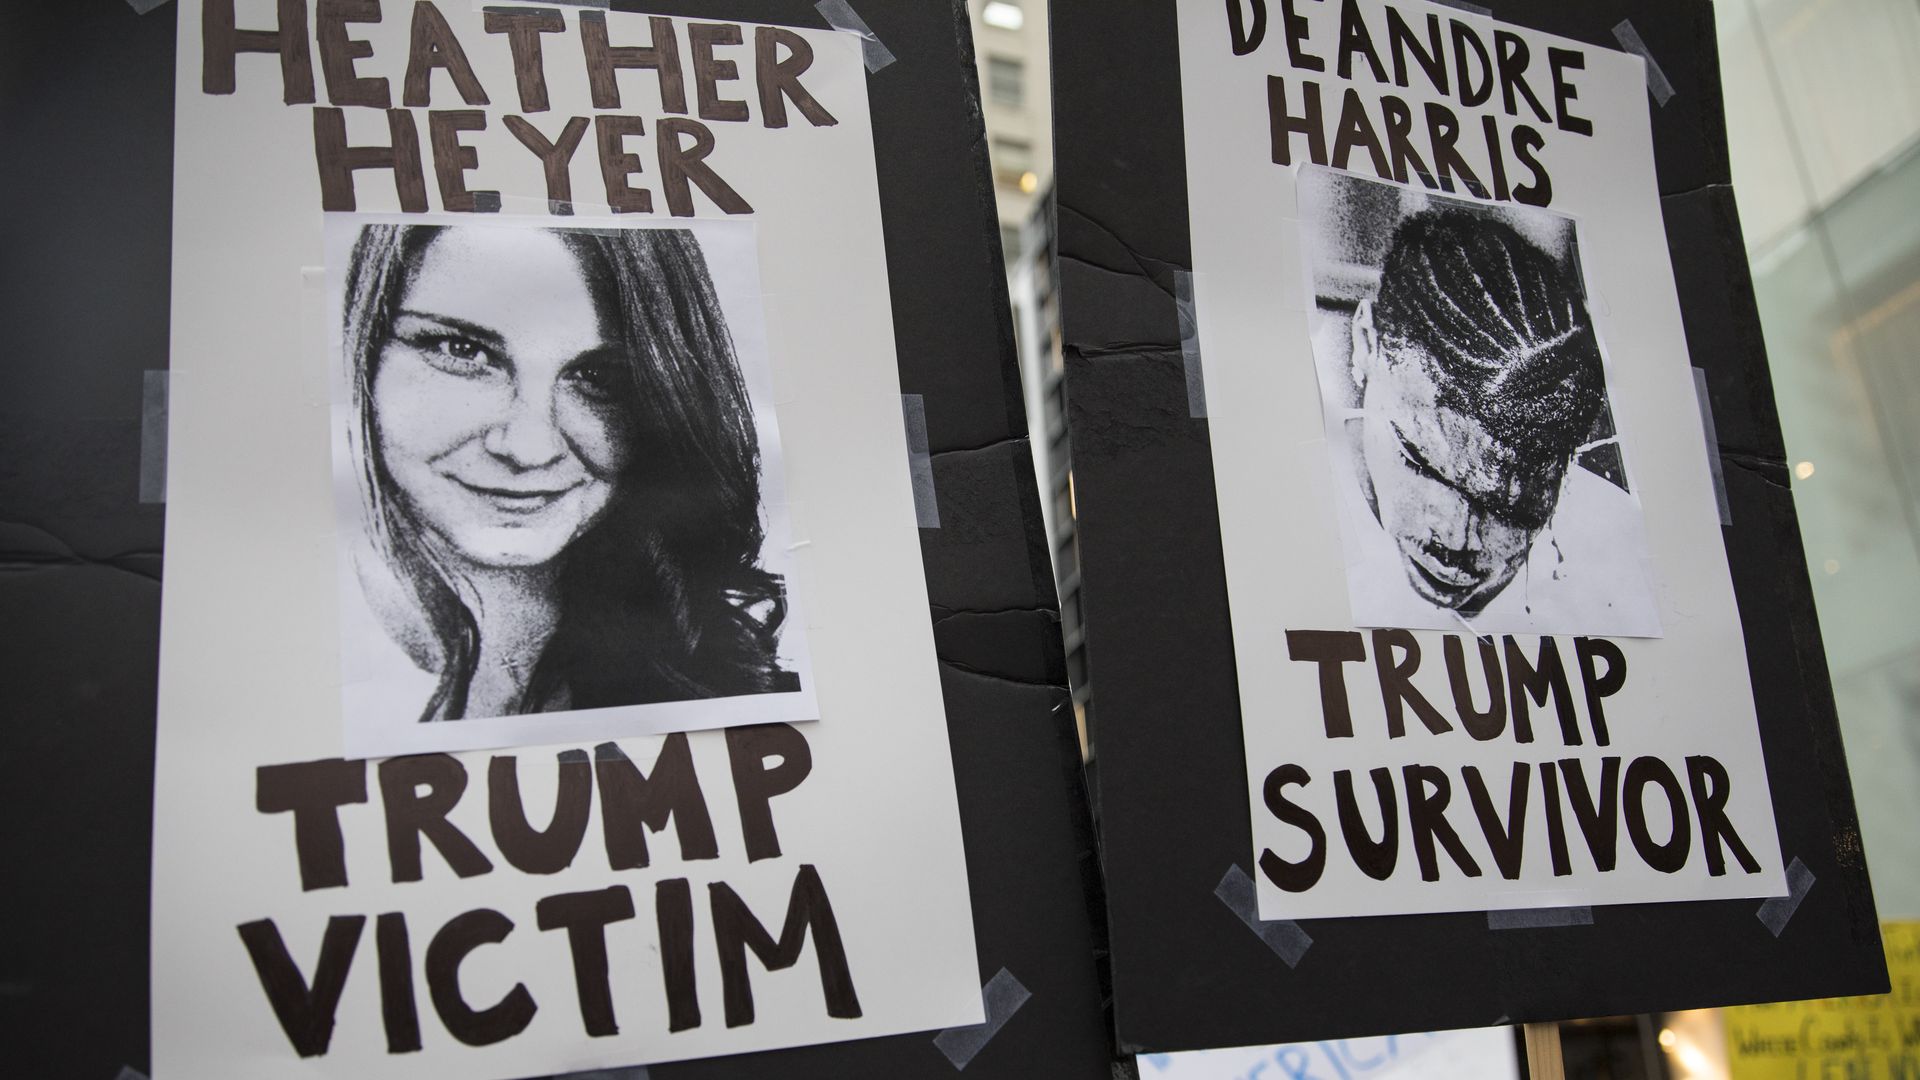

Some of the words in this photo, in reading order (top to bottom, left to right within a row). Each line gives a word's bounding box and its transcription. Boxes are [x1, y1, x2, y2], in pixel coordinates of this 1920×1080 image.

[201, 0, 838, 128] HEATHER
[1226, 0, 1593, 137] DEANDRE
[312, 106, 754, 217] HEYER
[1267, 74, 1552, 208] HARRIS
[1285, 628, 1627, 747] TRUMP
[256, 722, 813, 891] TRUMP
[1258, 755, 1762, 893] SURVIVOR
[236, 864, 863, 1058] VICTIM
